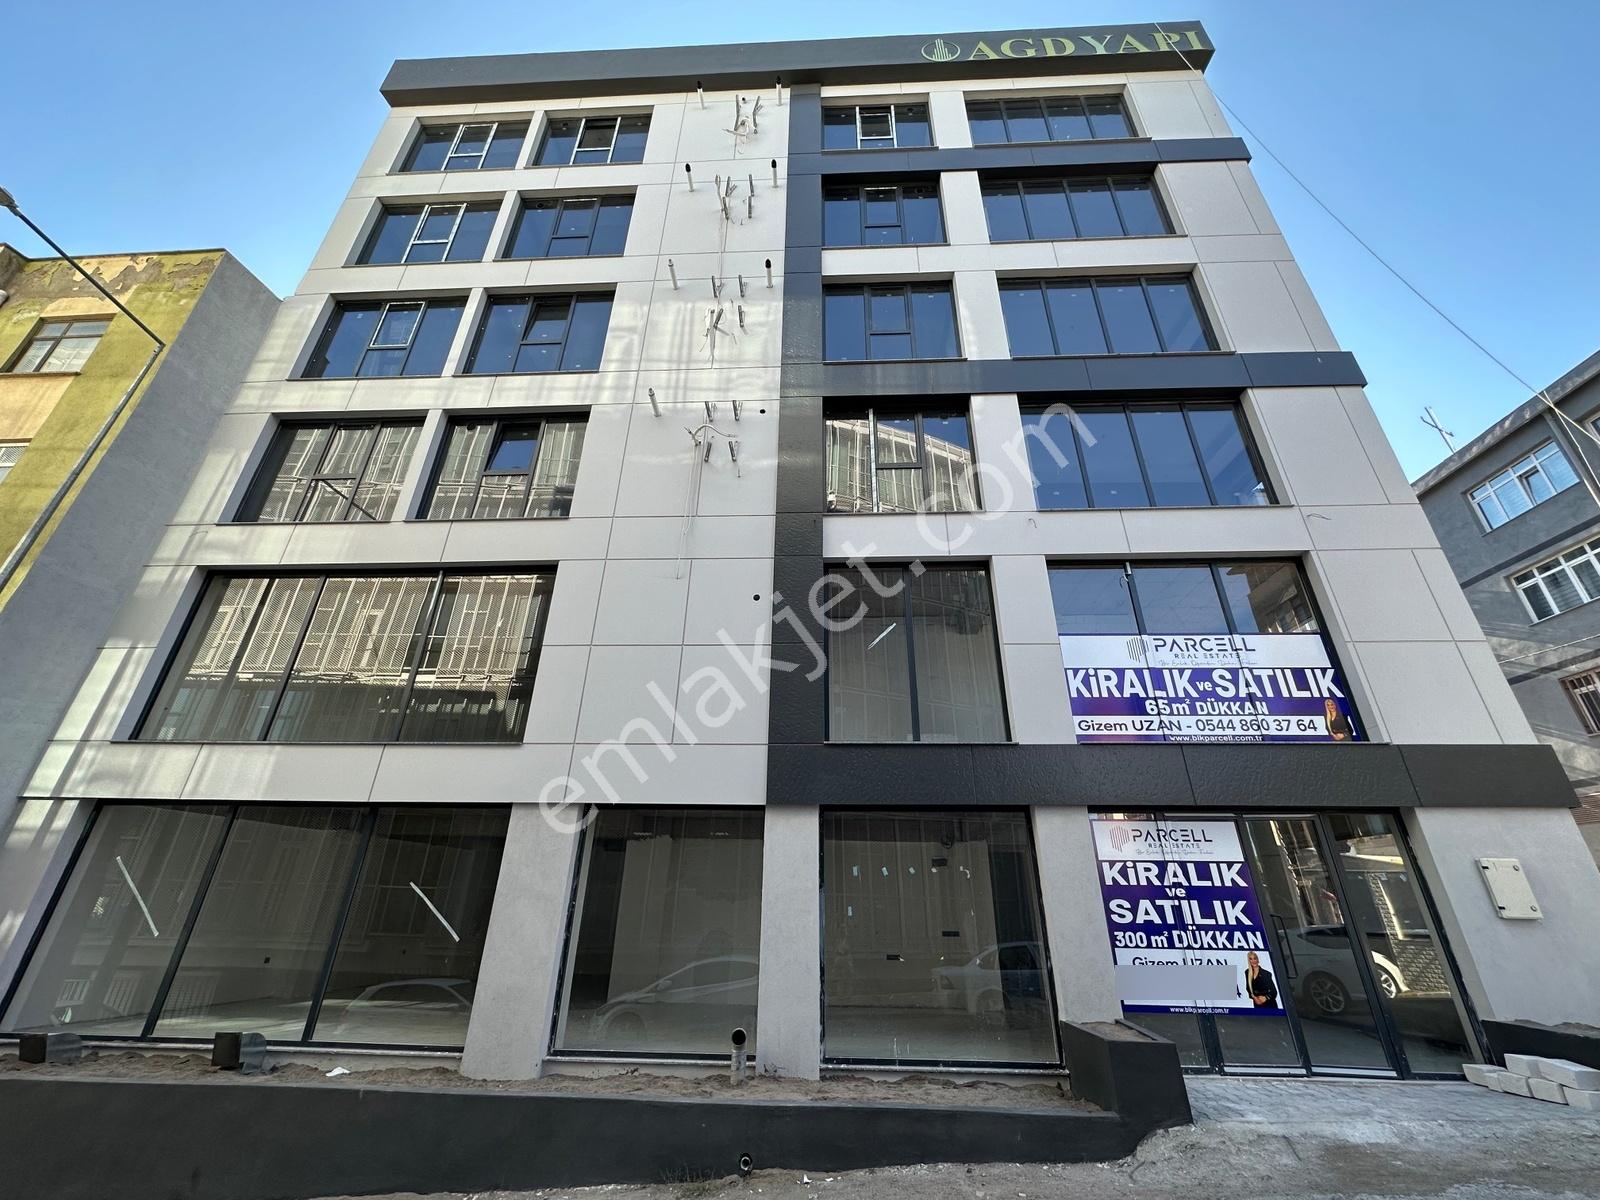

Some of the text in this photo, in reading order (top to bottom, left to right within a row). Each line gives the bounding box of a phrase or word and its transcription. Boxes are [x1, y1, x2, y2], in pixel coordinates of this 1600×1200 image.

[1153, 638, 1256, 652] PARCELL
[1196, 681, 1213, 692] ve
[1211, 668, 1344, 698] SATILIK
[1145, 700, 1171, 715] 65
[1195, 698, 1269, 715] DÜKKAN
[1077, 719, 1129, 733] Gizem
[1131, 719, 1182, 732] UZAN
[1195, 719, 1237, 732] 0544
[1239, 719, 1270, 732] 860
[1274, 719, 1292, 732] 37
[1296, 719, 1318, 732] 64
[1131, 829, 1213, 842] PARCELL
[1165, 888, 1186, 897] ve
[1108, 899, 1253, 926] SATILIK
[1114, 932, 1147, 948] 300
[1172, 926, 1264, 949] DÜKKAN
